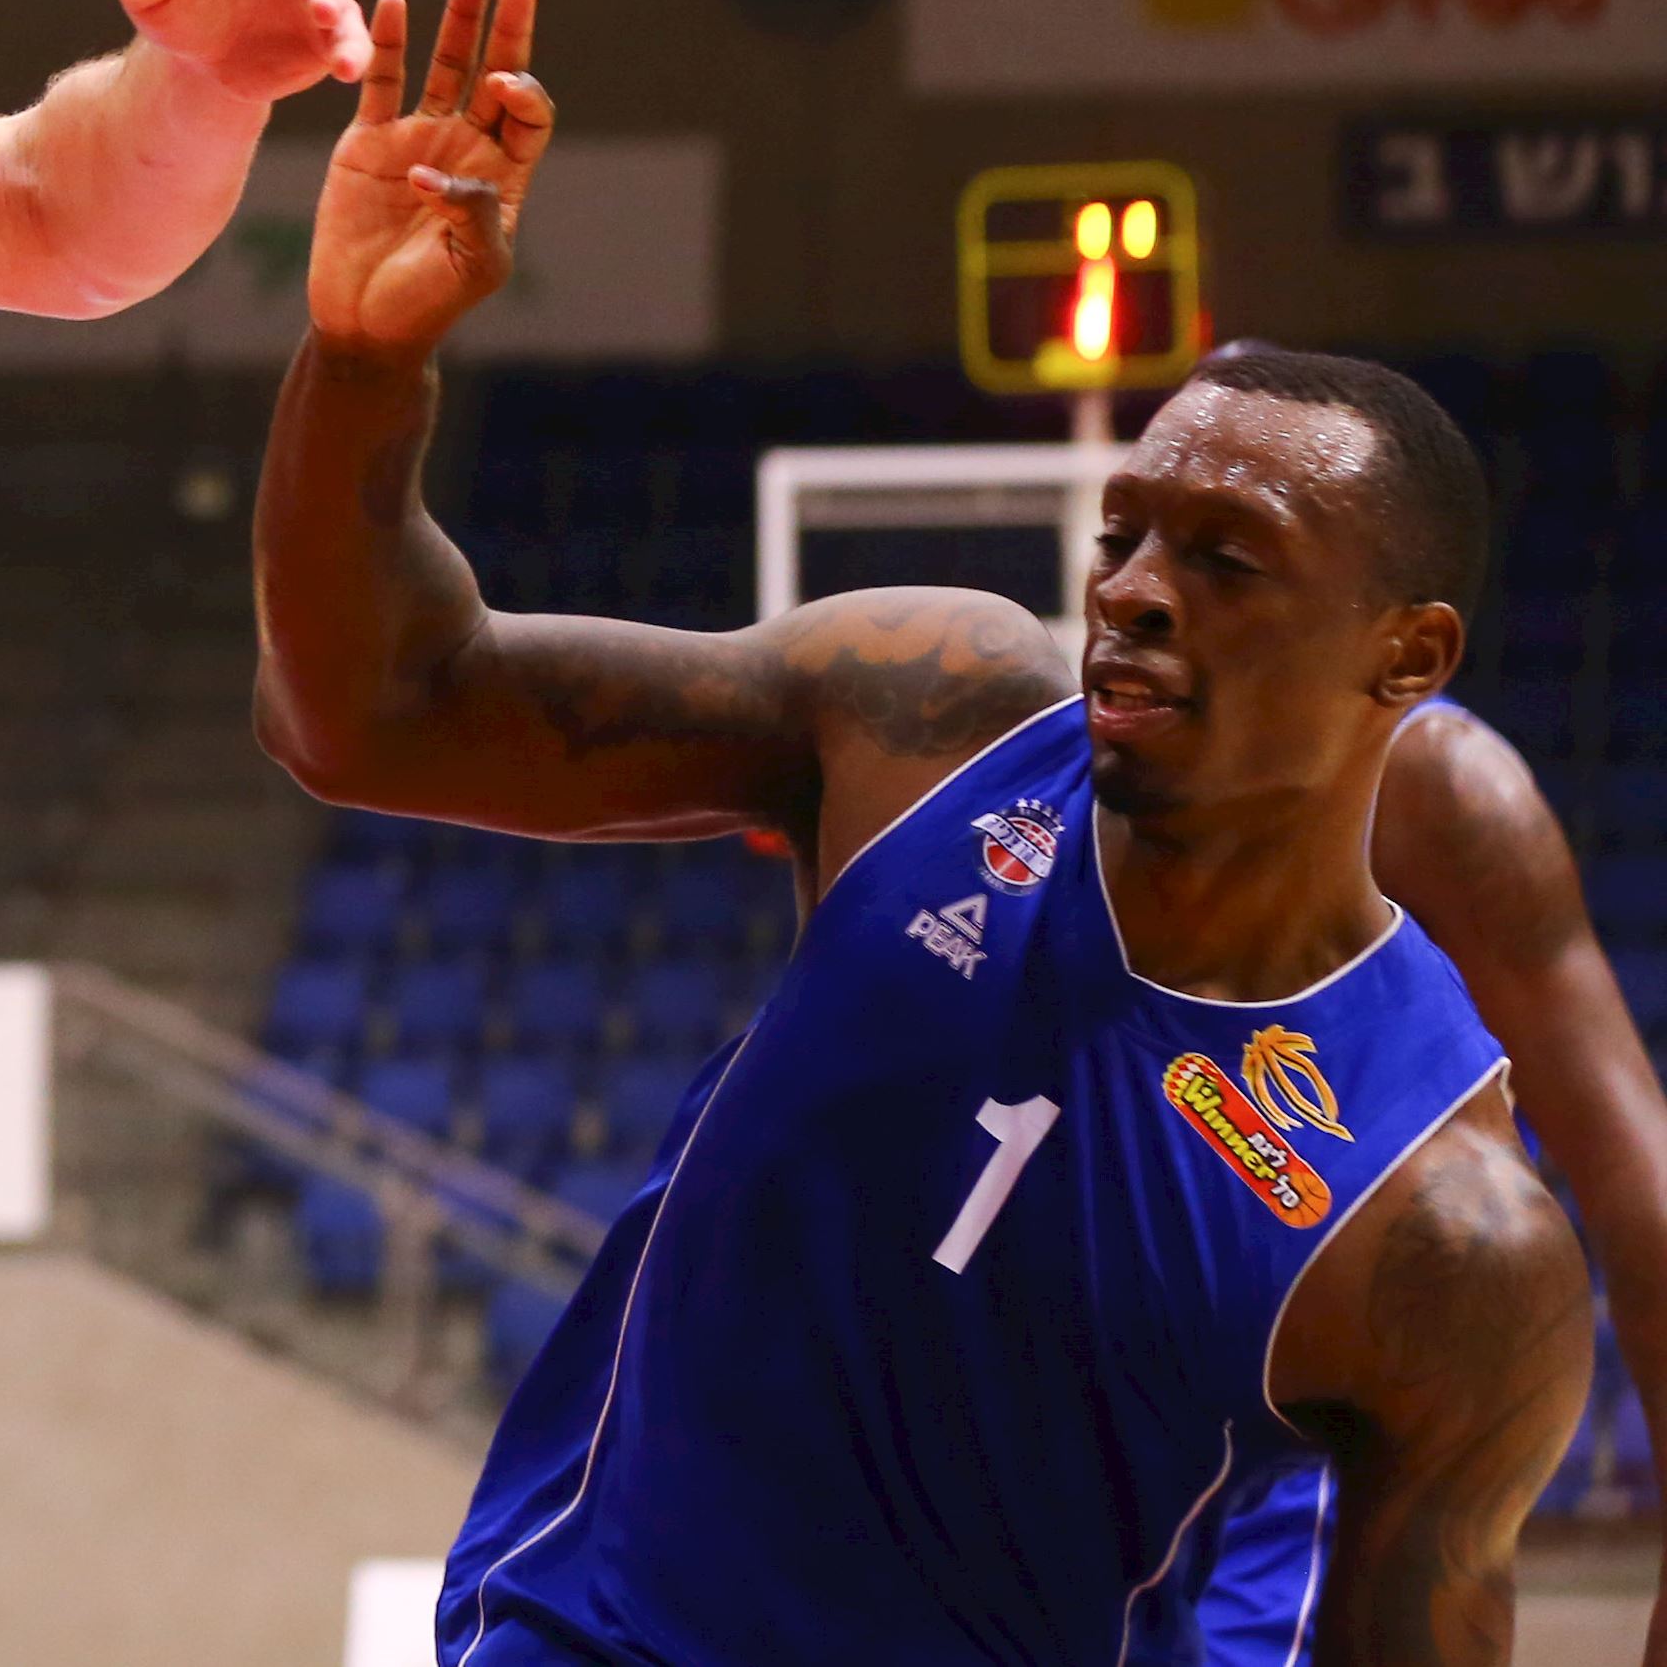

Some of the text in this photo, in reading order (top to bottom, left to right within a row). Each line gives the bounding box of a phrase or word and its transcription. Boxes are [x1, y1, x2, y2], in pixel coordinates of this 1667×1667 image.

[1499, 132, 1667, 219] וש
[905, 908, 988, 981] PEAK
[931, 1094, 1062, 1275] 1
[1183, 1074, 1301, 1209] Winner סל
